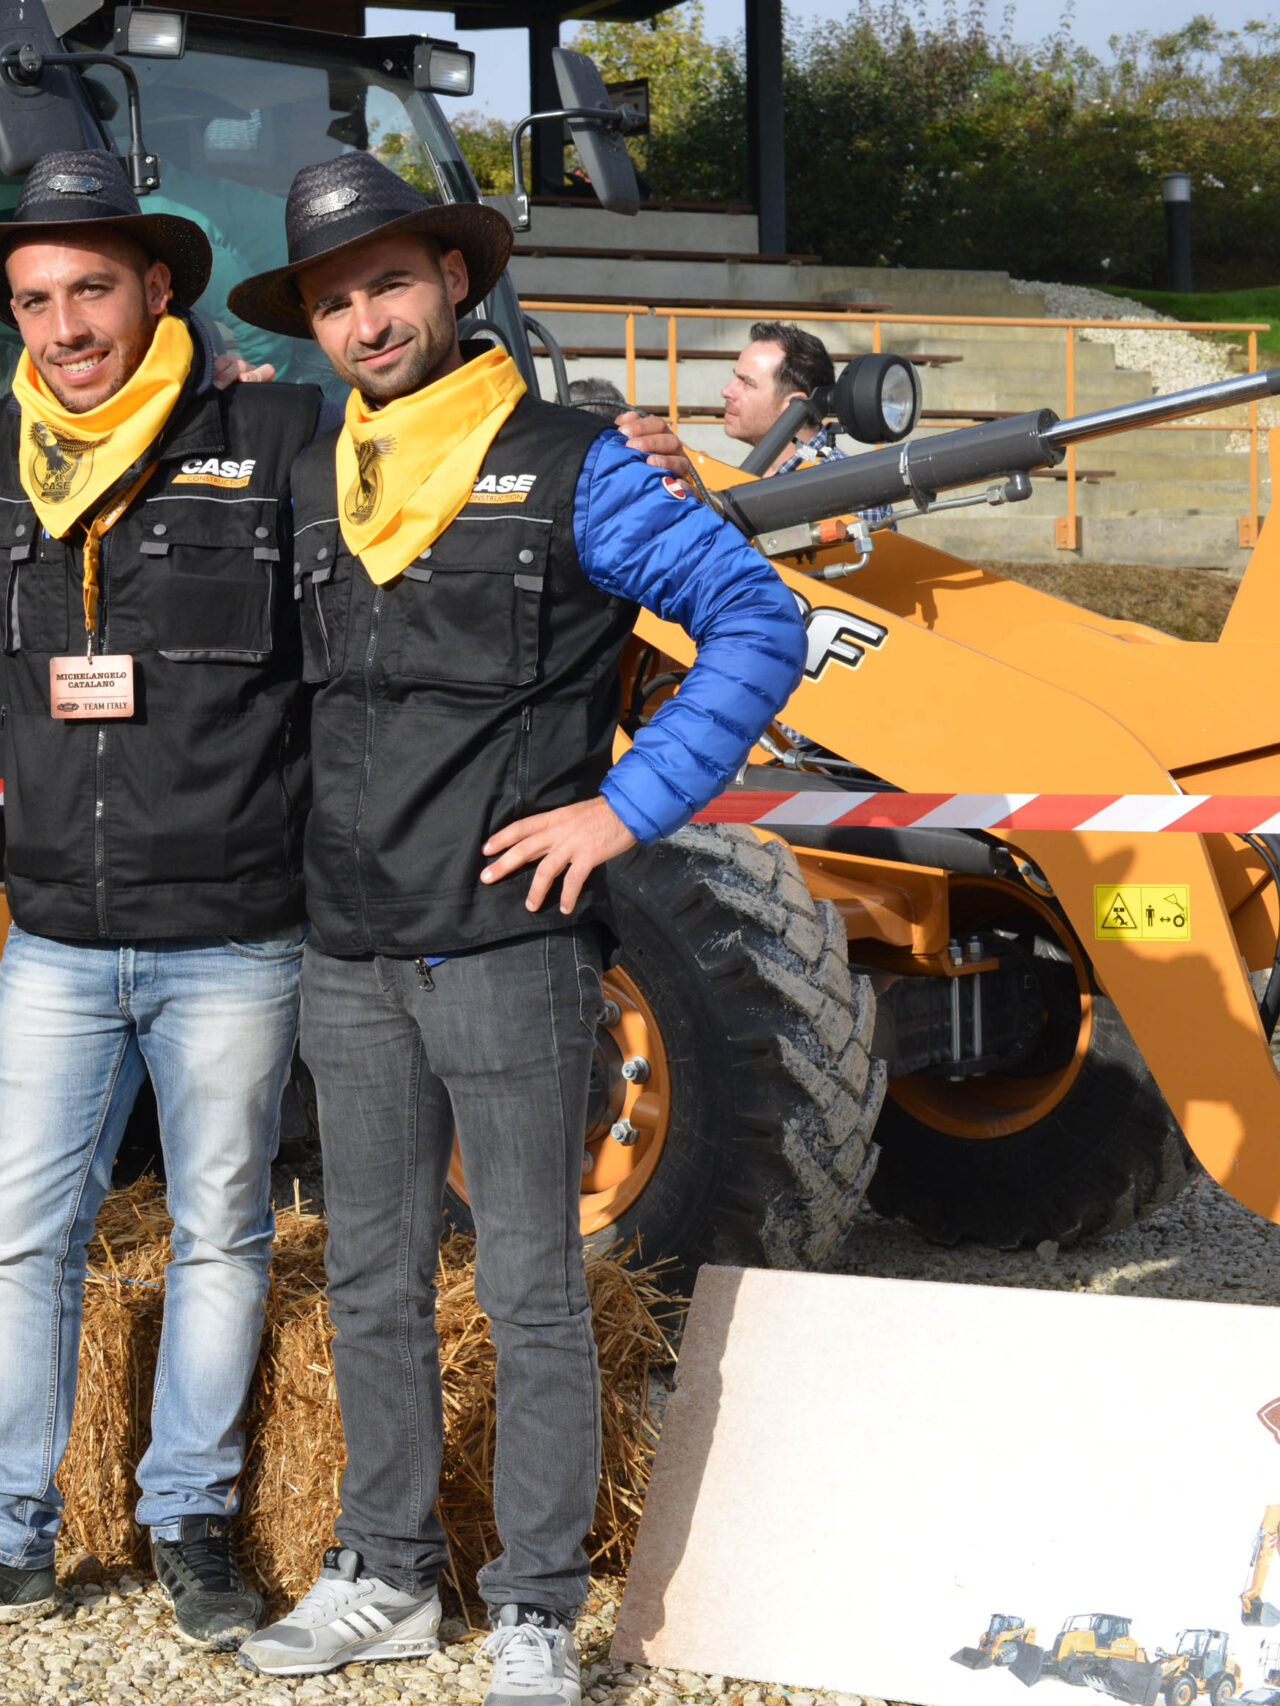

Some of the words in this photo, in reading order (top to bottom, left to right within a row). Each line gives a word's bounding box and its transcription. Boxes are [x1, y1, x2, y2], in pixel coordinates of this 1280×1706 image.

[181, 458, 256, 478] CASE
[186, 475, 248, 486] CONSTRUCTION
[473, 474, 537, 493] ASE
[42, 481, 71, 491] CASE
[469, 493, 523, 502] ONSTRUCTION
[56, 672, 127, 681] MICHELANGELO
[68, 681, 115, 689] CATALANO
[83, 703, 105, 711] TEAM
[107, 702, 128, 710] ITALY
